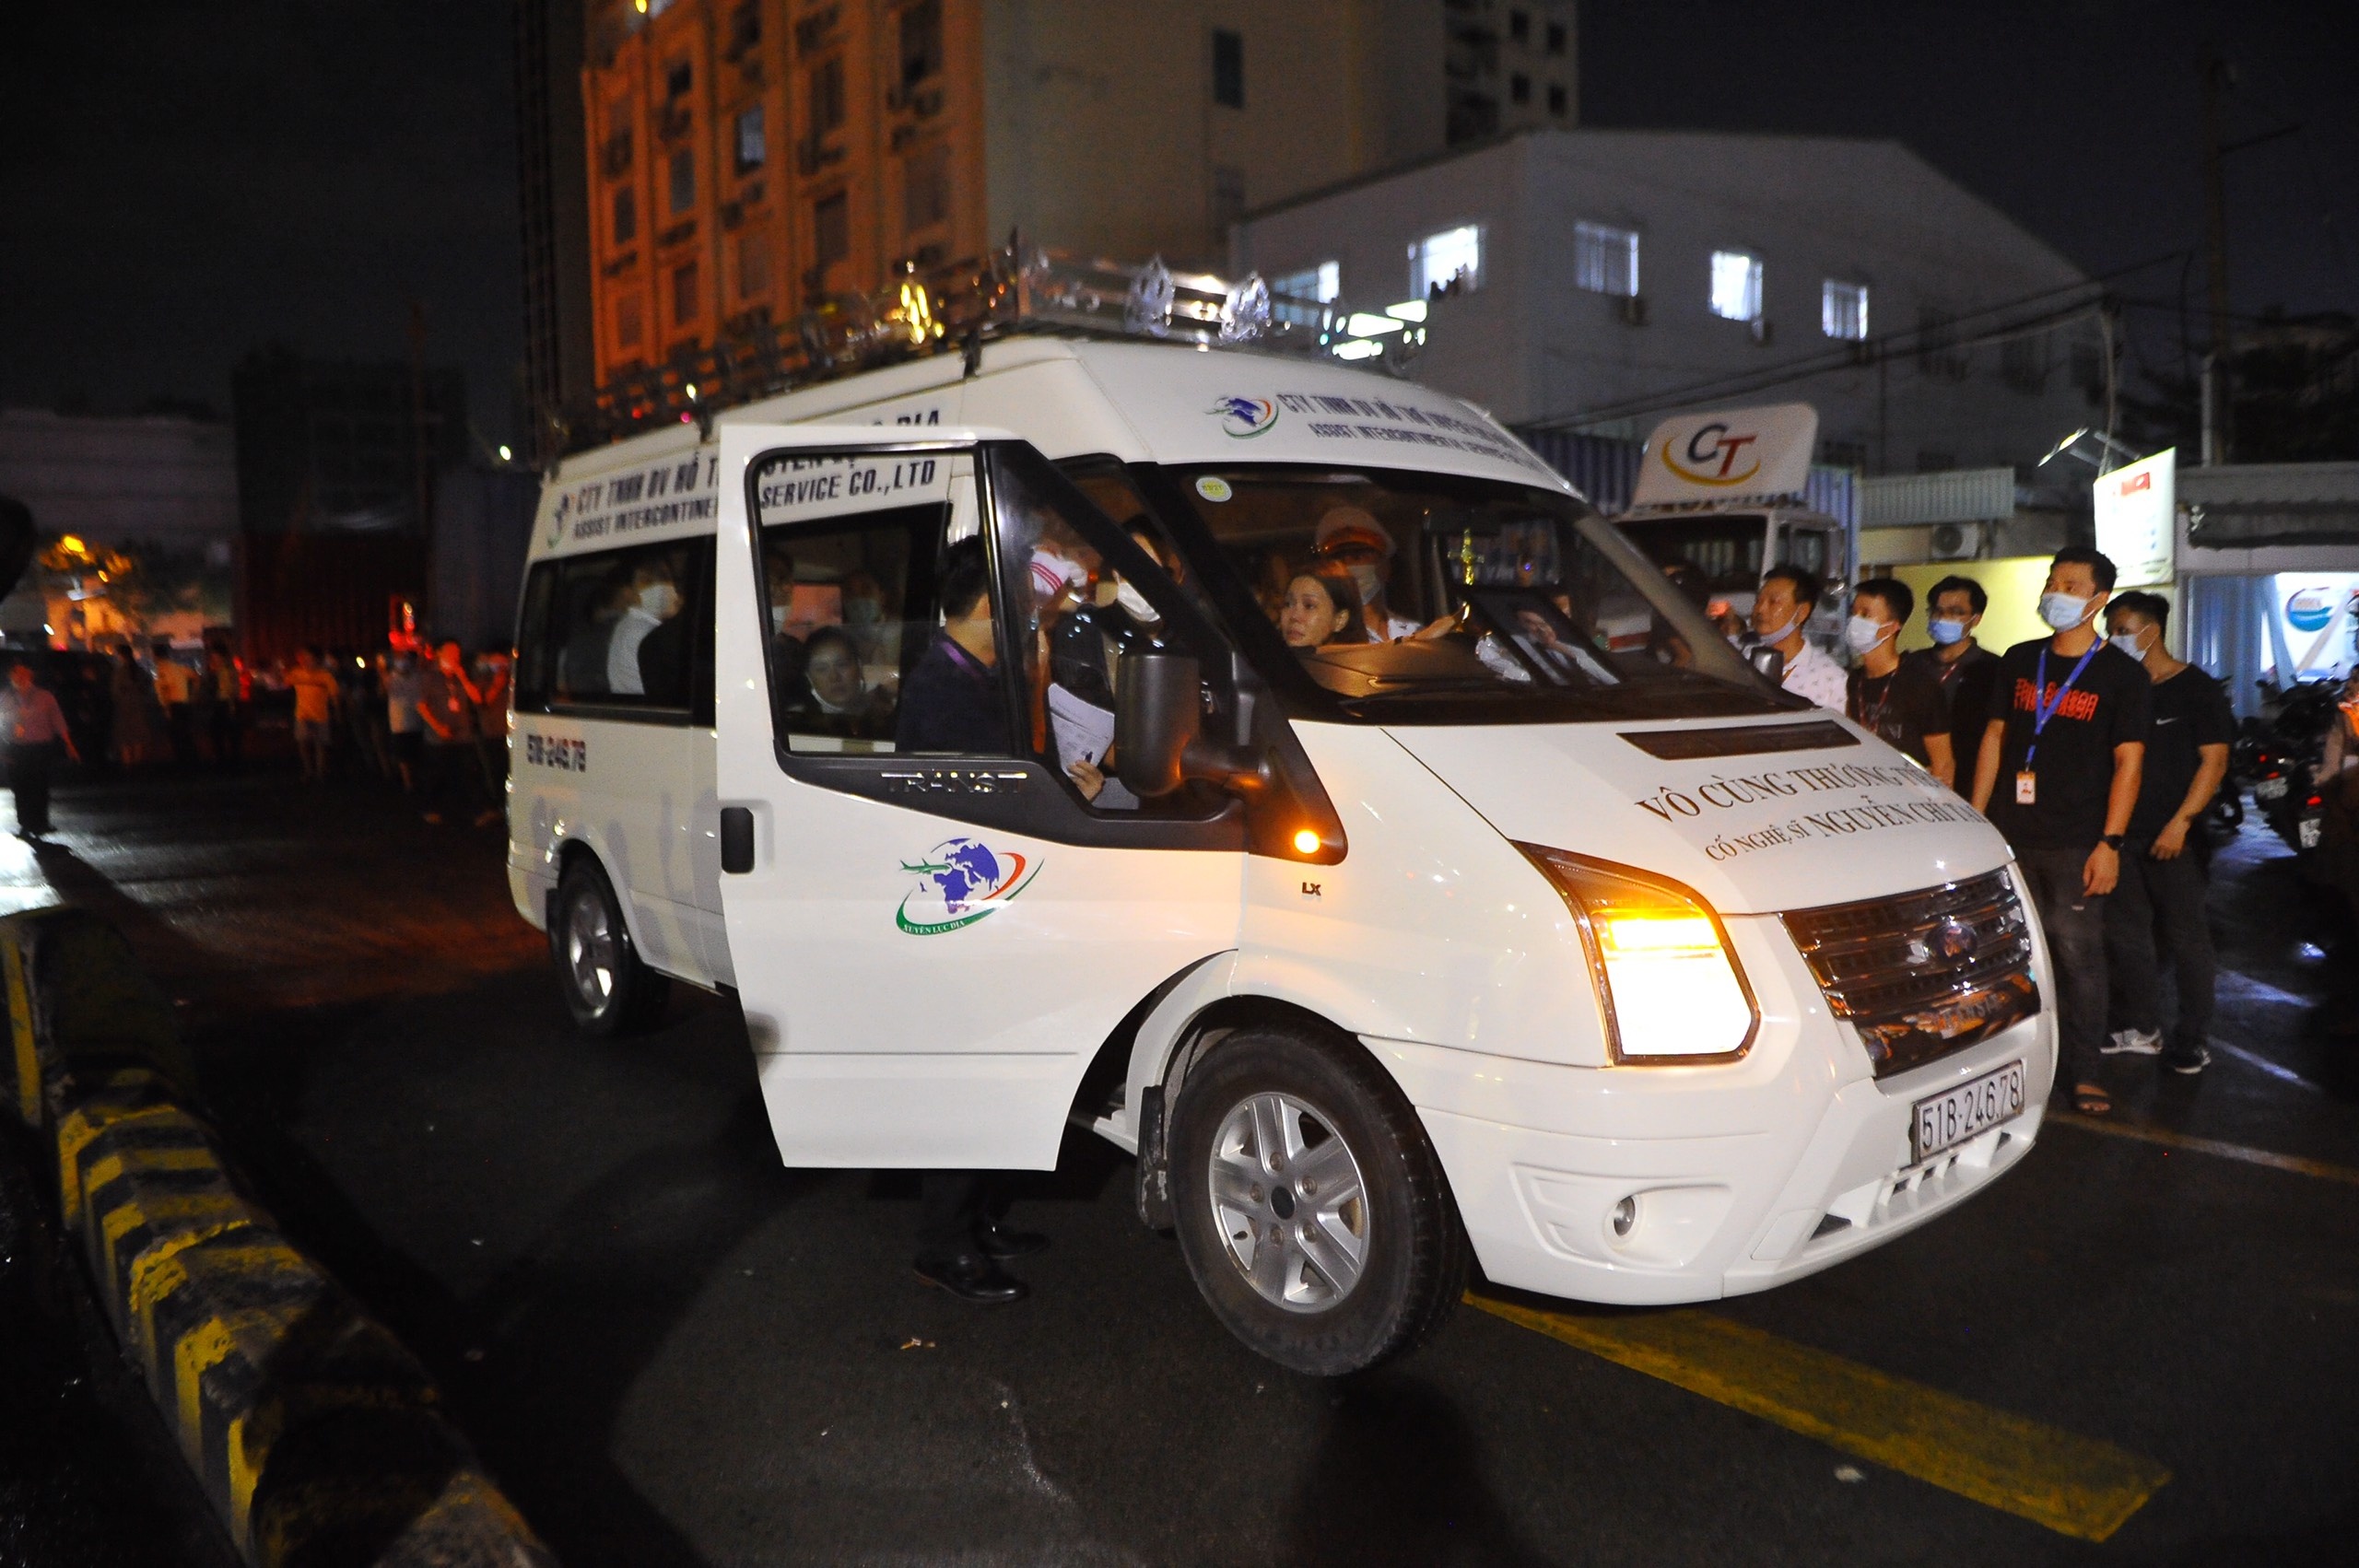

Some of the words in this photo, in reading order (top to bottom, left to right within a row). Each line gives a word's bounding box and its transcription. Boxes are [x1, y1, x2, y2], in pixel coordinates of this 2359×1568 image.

[1688, 423, 1757, 477] CT
[761, 474, 842, 509] SERVICE
[1634, 786, 1700, 823] VÔ
[1698, 775, 1797, 808] CÙNG
[1705, 834, 1737, 861] CỐ
[1734, 824, 1792, 853] NGHỆ
[1302, 882, 1321, 896] LX
